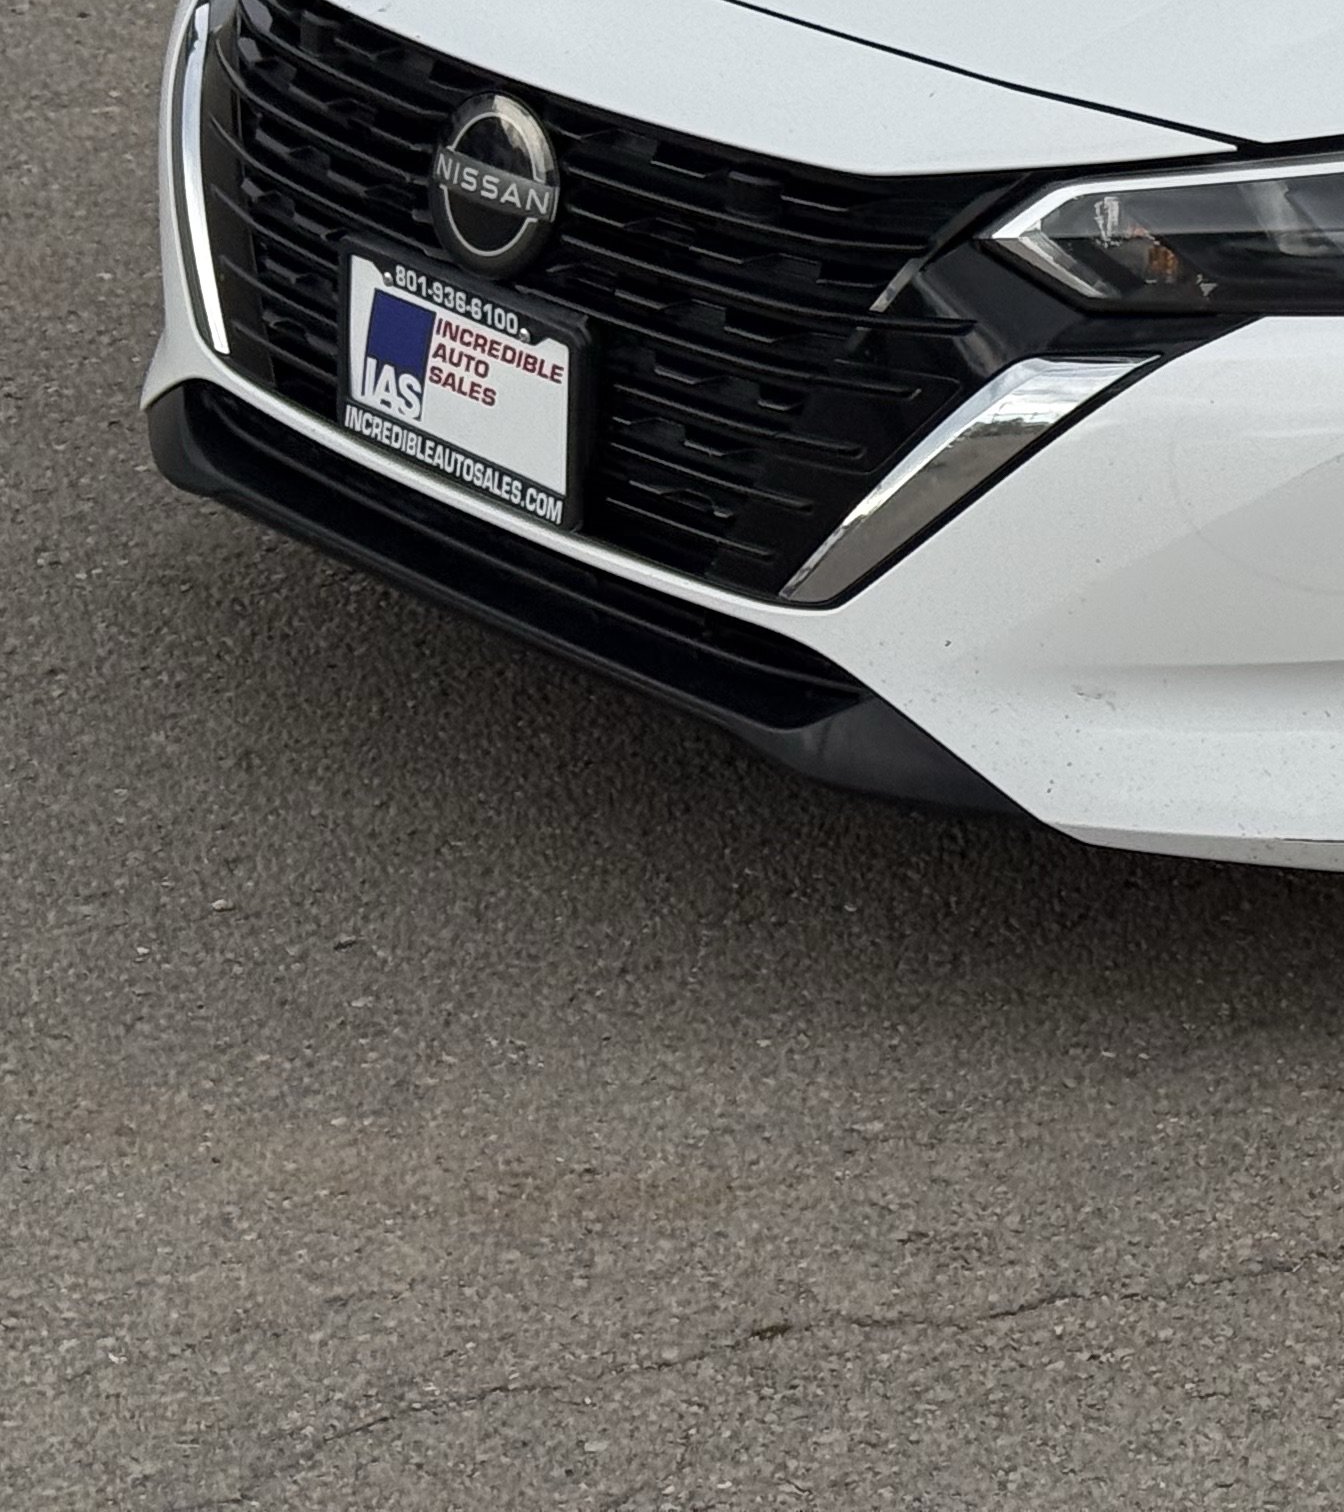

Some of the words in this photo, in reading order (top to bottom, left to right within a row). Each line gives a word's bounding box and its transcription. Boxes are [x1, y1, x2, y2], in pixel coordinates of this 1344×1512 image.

[437, 153, 549, 214] NISSAN
[395, 265, 519, 334] 801-936-6100
[432, 343, 490, 379] AUTO
[436, 317, 565, 384] INCREDIBLE
[361, 356, 422, 423] IAS
[428, 367, 497, 407] SALES
[344, 405, 563, 525] INCREDIBLEAUTOSALES.COM
